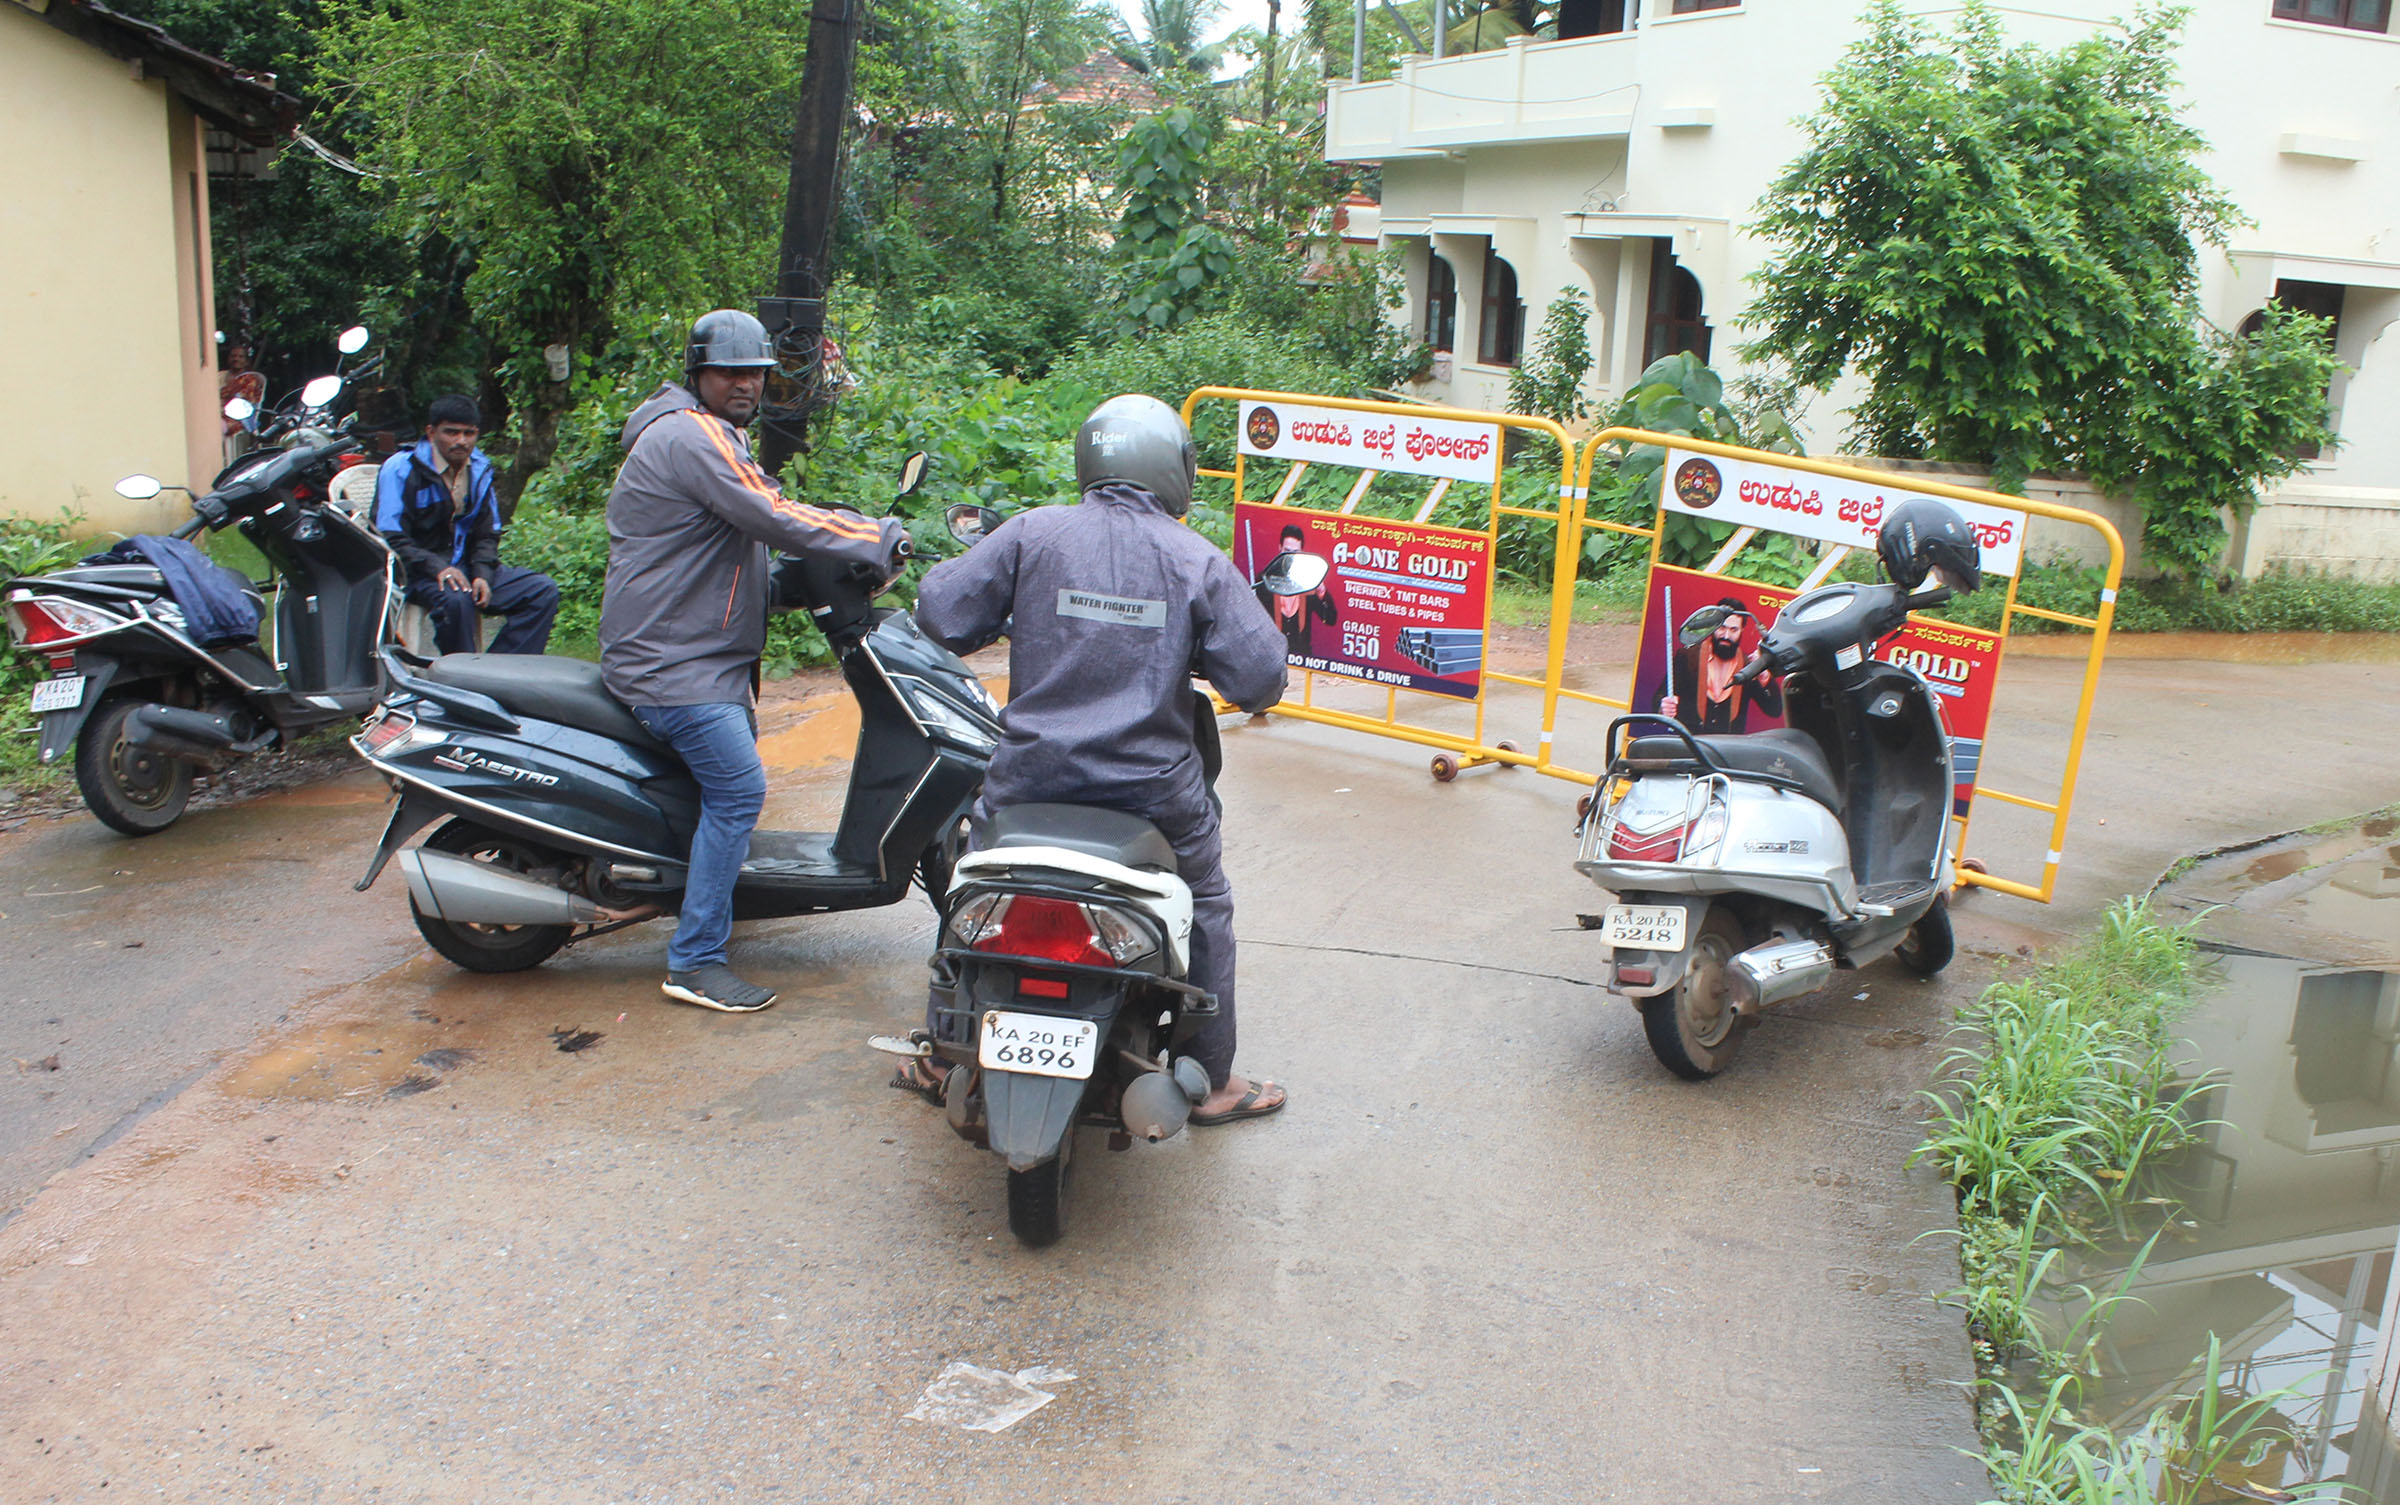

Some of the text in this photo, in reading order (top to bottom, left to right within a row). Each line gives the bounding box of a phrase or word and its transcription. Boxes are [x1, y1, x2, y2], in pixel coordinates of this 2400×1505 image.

[1291, 418, 1490, 462] ಉಡುಪಿ ಜಿಲ್ಲೆ ಪೊಲೀಸ್
[1739, 479, 1823, 516] ಉಡುಪಿ
[1837, 495, 1884, 539] ಜಿಲ್ಲೆ
[1333, 542, 1400, 571] A-ONE
[1408, 553, 1469, 581] GOLD
[1069, 595, 1144, 614] WATER FIGHTER
[1347, 597, 1445, 622] STEEL TUBES & PIPES
[1396, 590, 1418, 603] TMT
[1419, 594, 1450, 608] BARS
[1342, 620, 1380, 637] GRADE
[1342, 633, 1380, 661] 550
[1287, 653, 1411, 686] DO NOT DRINK & DRIVE
[1888, 645, 1971, 683] GOLD
[448, 746, 559, 786] MAESTRO
[1613, 914, 1677, 927] KA 20 ED
[1613, 927, 1671, 942] 5248
[991, 1027, 1085, 1048] KA 20 EF
[997, 1044, 1075, 1069] 6896
